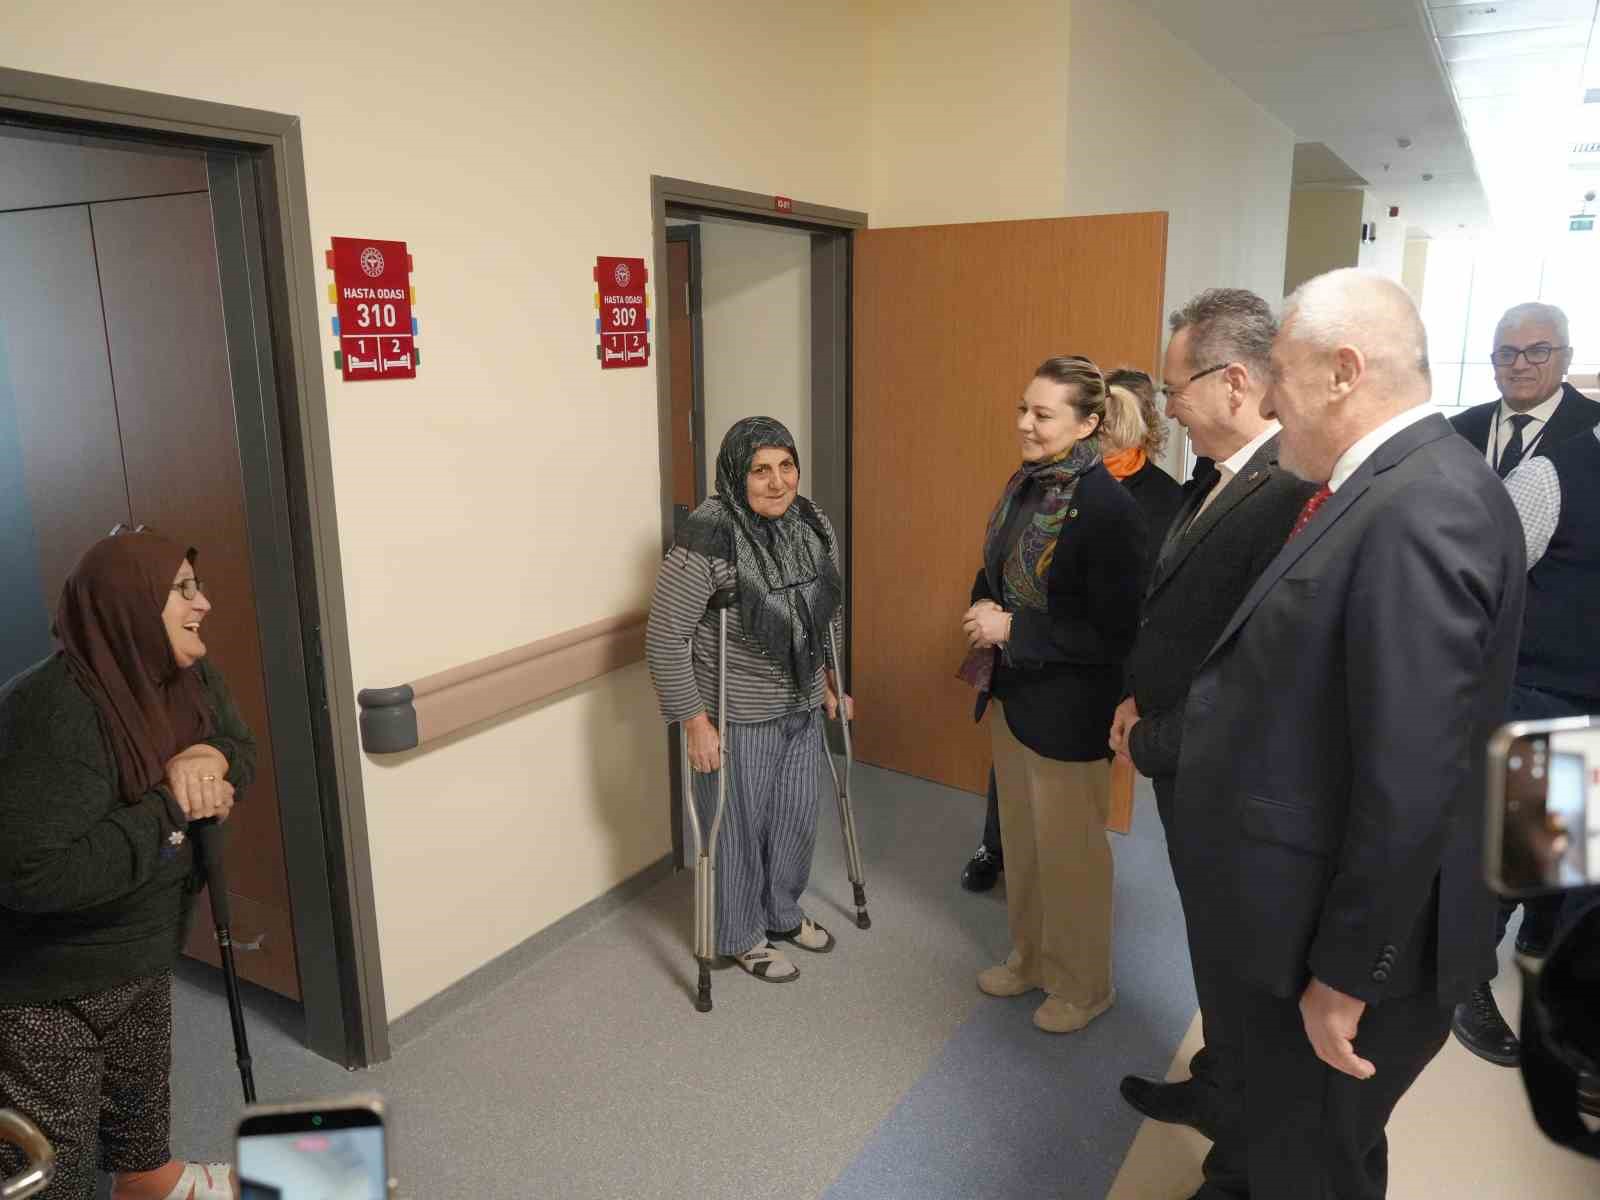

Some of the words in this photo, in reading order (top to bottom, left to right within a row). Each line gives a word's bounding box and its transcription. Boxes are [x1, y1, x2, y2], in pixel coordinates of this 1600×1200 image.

[344, 287, 375, 299] HASTA
[377, 288, 405, 299] ODASI
[604, 295, 624, 304] HASTA
[624, 296, 643, 304] ODASI
[357, 303, 396, 327] 310
[612, 307, 637, 326] 309
[358, 340, 365, 354] 1
[392, 339, 401, 353] 2
[611, 336, 617, 347] 1
[632, 336, 639, 346] 2
